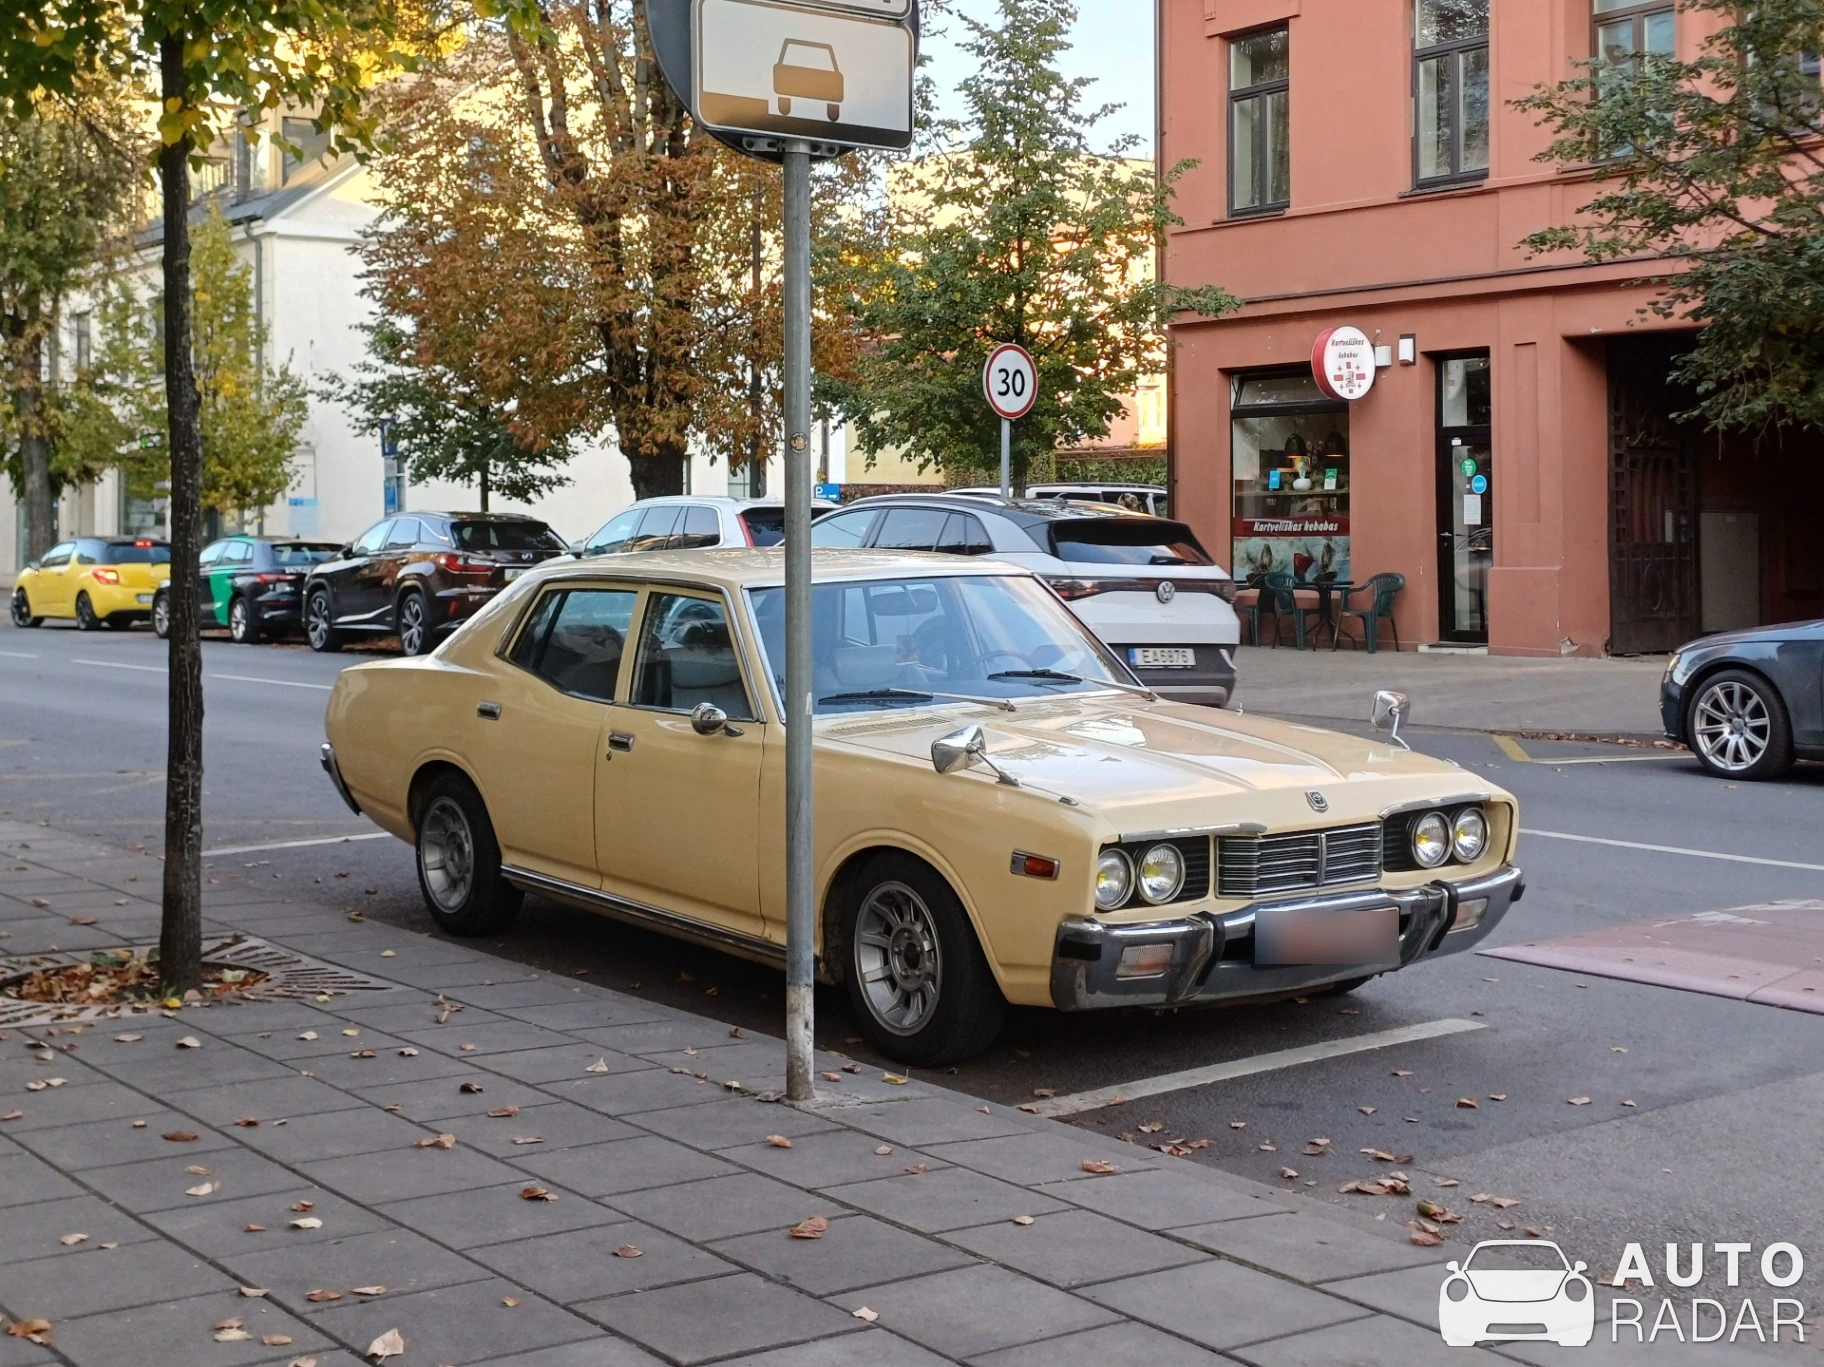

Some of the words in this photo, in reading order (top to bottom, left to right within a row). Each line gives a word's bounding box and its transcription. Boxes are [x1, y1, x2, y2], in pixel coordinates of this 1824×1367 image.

[997, 368, 1026, 397] 30
[815, 486, 823, 498] P
[1253, 520, 1302, 532] Kartveliškas
[1303, 520, 1339, 532] kebabas
